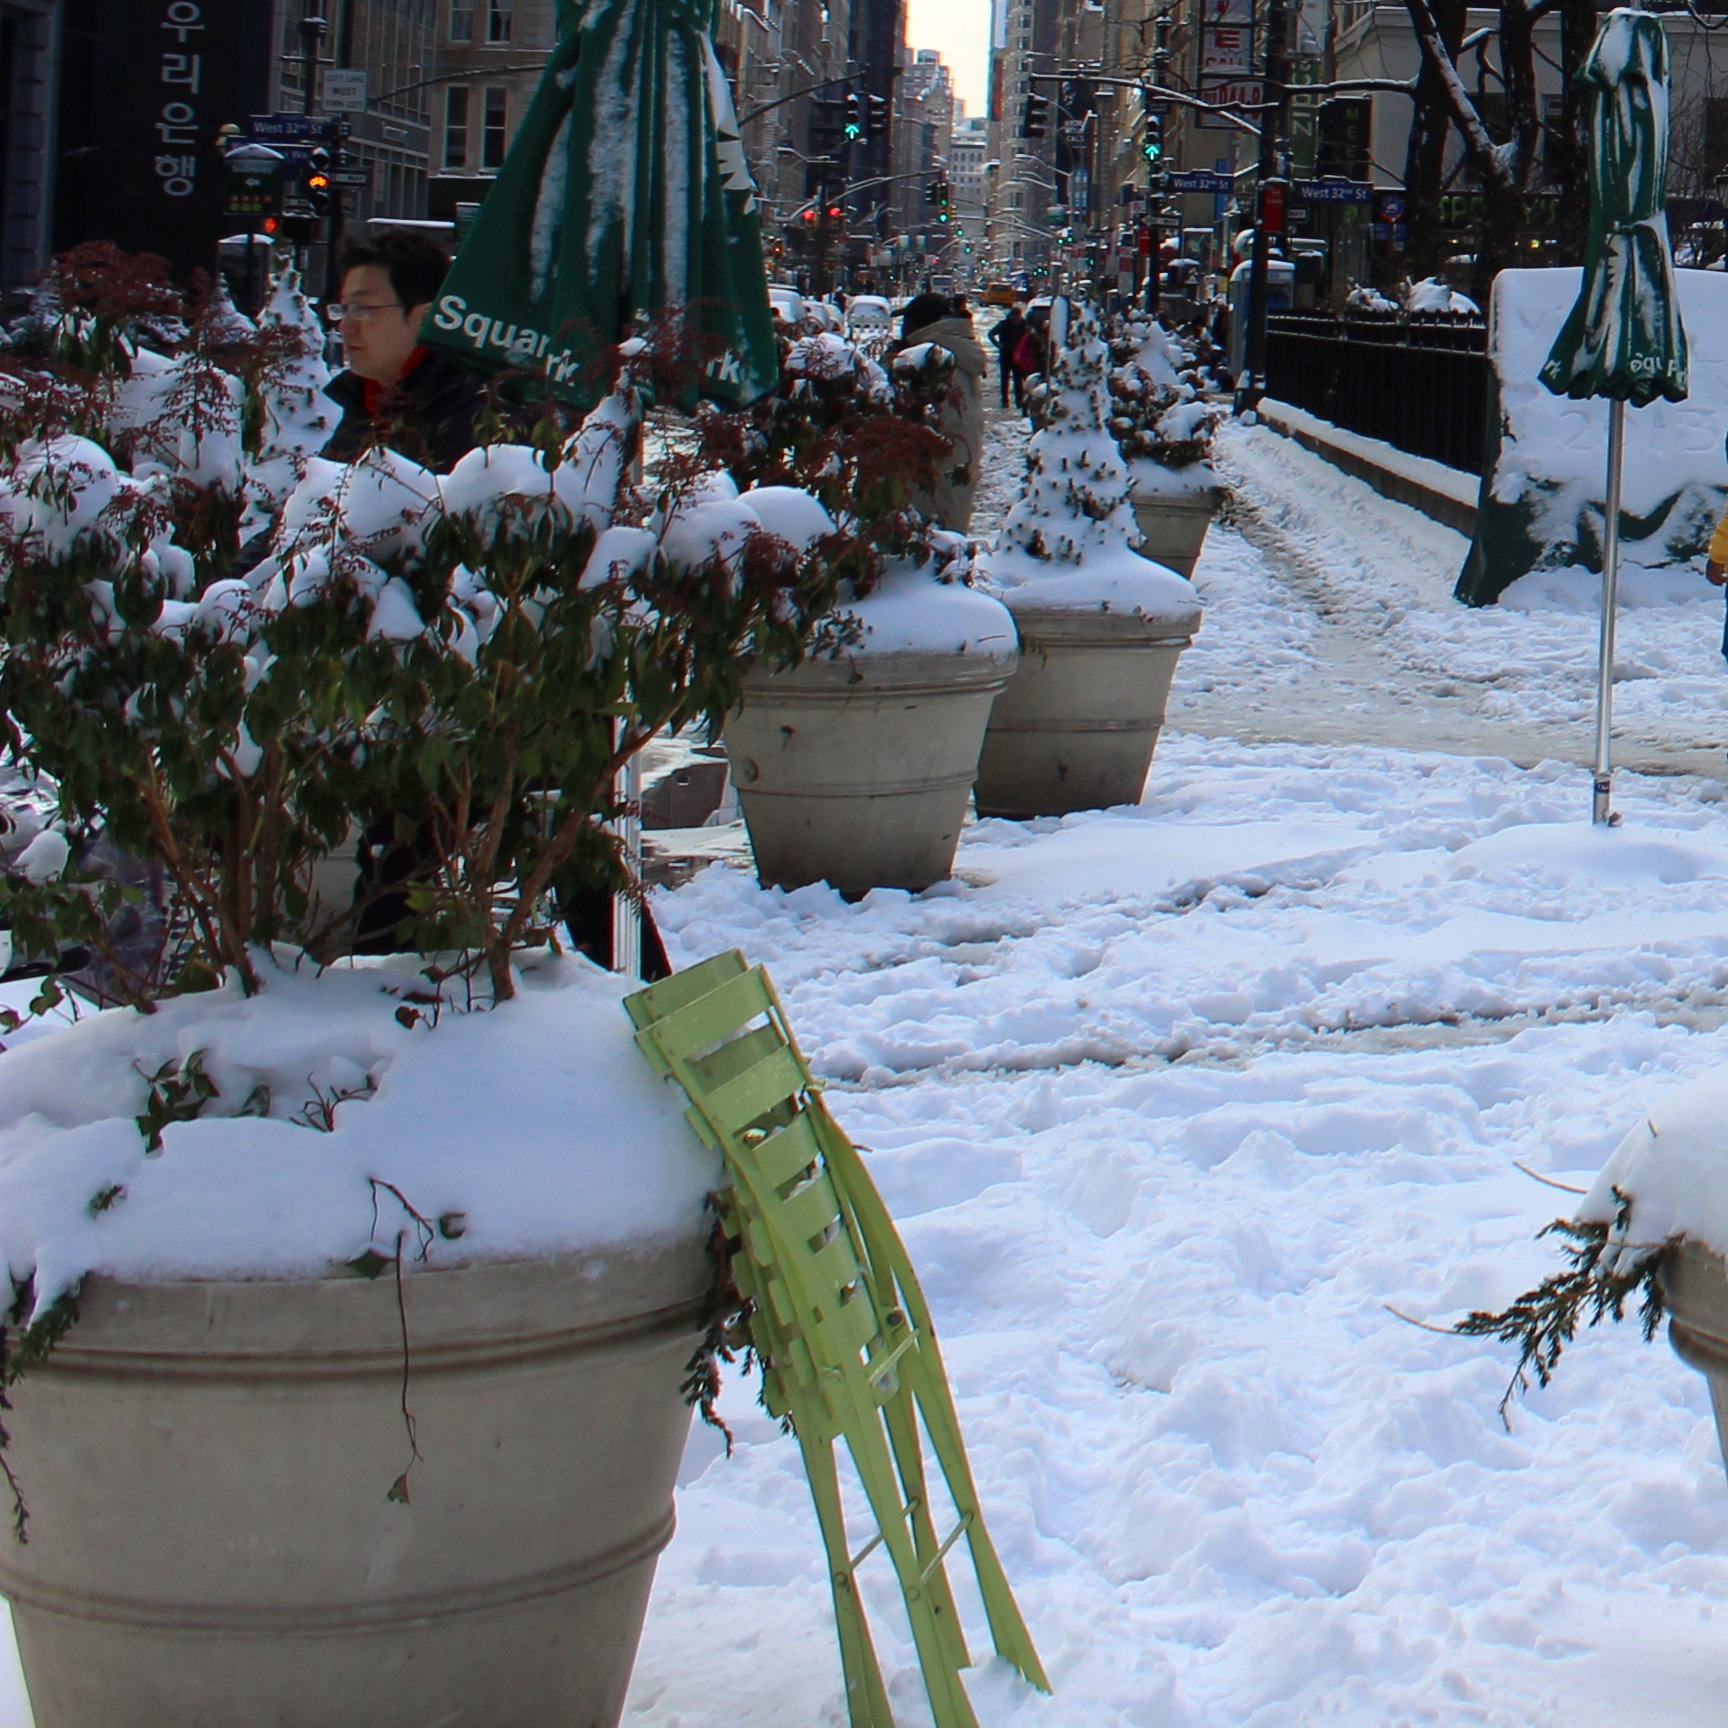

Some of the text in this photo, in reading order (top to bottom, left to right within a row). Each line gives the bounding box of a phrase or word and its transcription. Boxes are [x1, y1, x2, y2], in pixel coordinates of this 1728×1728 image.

[154, 1, 205, 197] 우리은행
[253, 122, 283, 134] West
[311, 124, 323, 135] St
[1173, 177, 1198, 188] West
[1219, 179, 1229, 190] St
[1301, 185, 1329, 199] West
[1355, 188, 1367, 200] St
